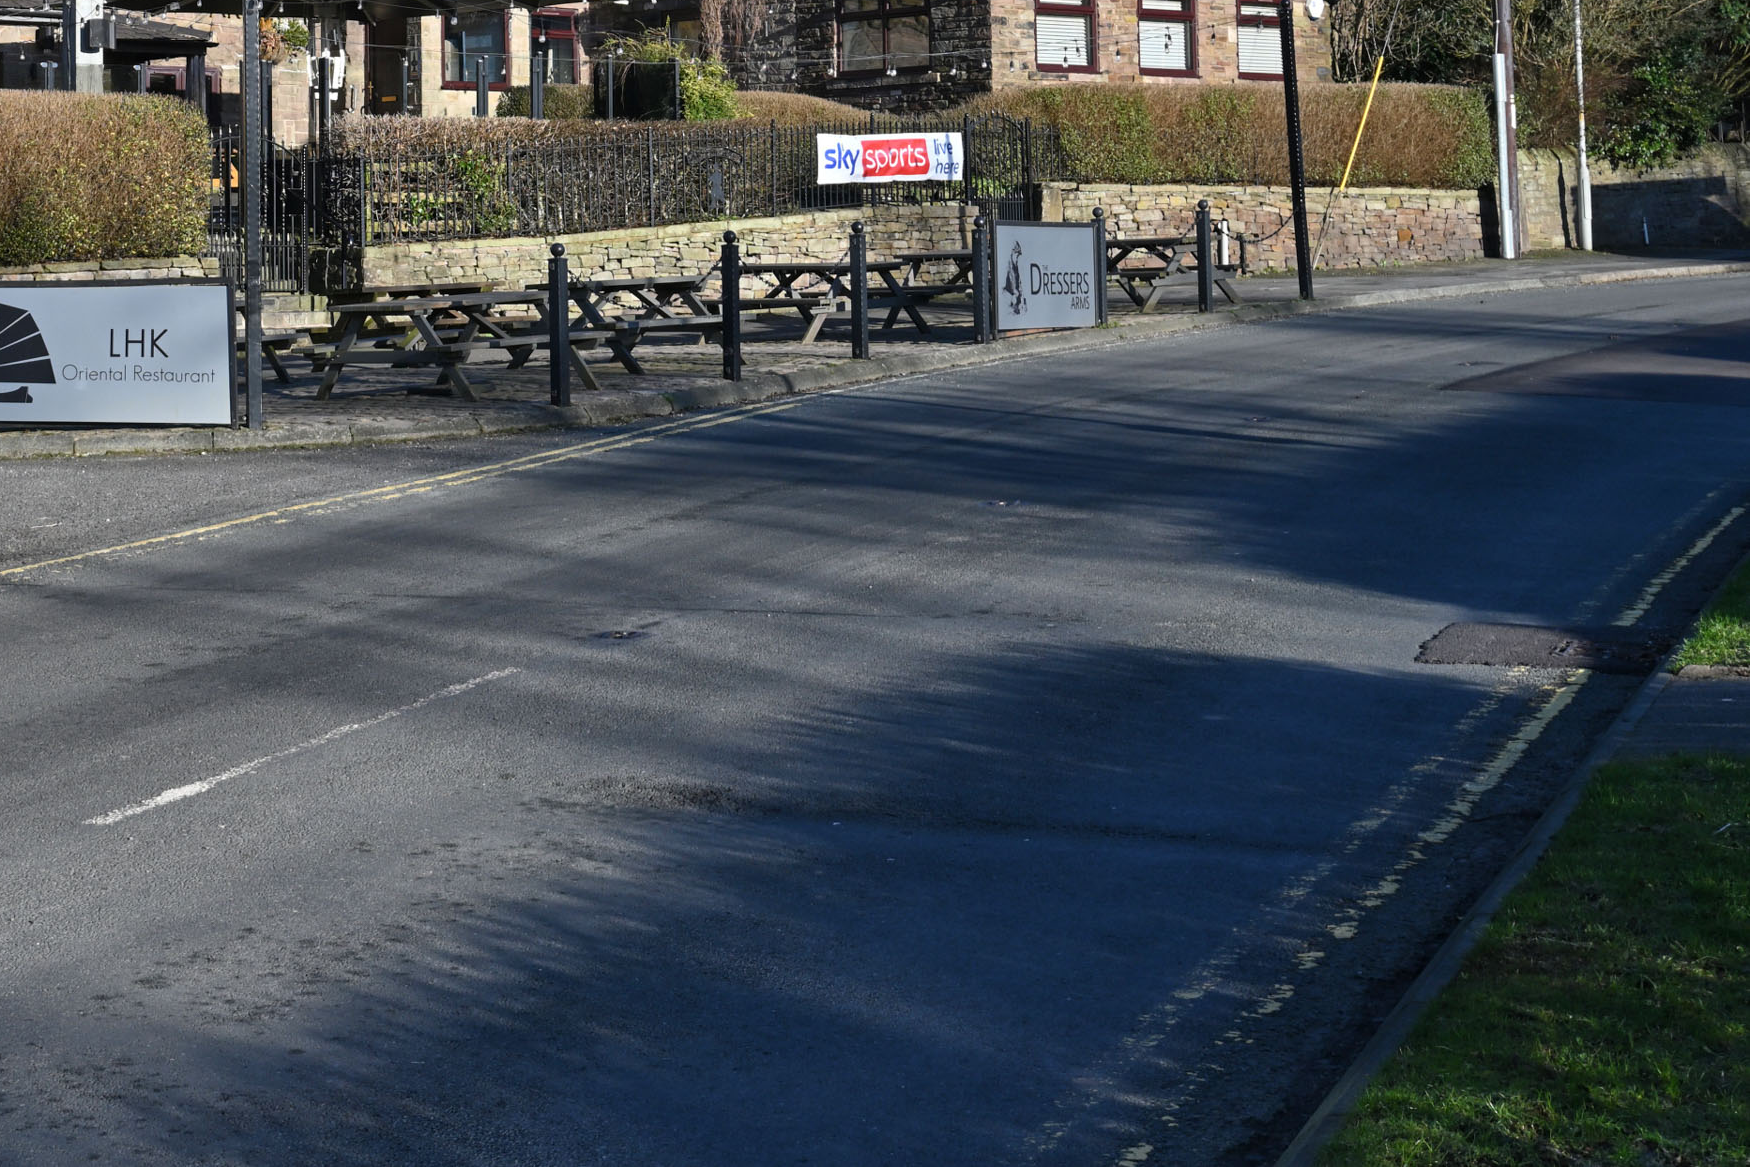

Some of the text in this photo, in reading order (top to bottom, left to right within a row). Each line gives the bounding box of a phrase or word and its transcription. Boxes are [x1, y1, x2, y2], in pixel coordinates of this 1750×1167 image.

[933, 138, 953, 155] live
[824, 142, 926, 175] sky sports
[935, 160, 960, 174] here
[1030, 263, 1090, 296] DRESSERS
[1071, 296, 1090, 310] ARMS
[110, 328, 169, 358] LHK
[62, 364, 215, 383] Oriental Restaurant
